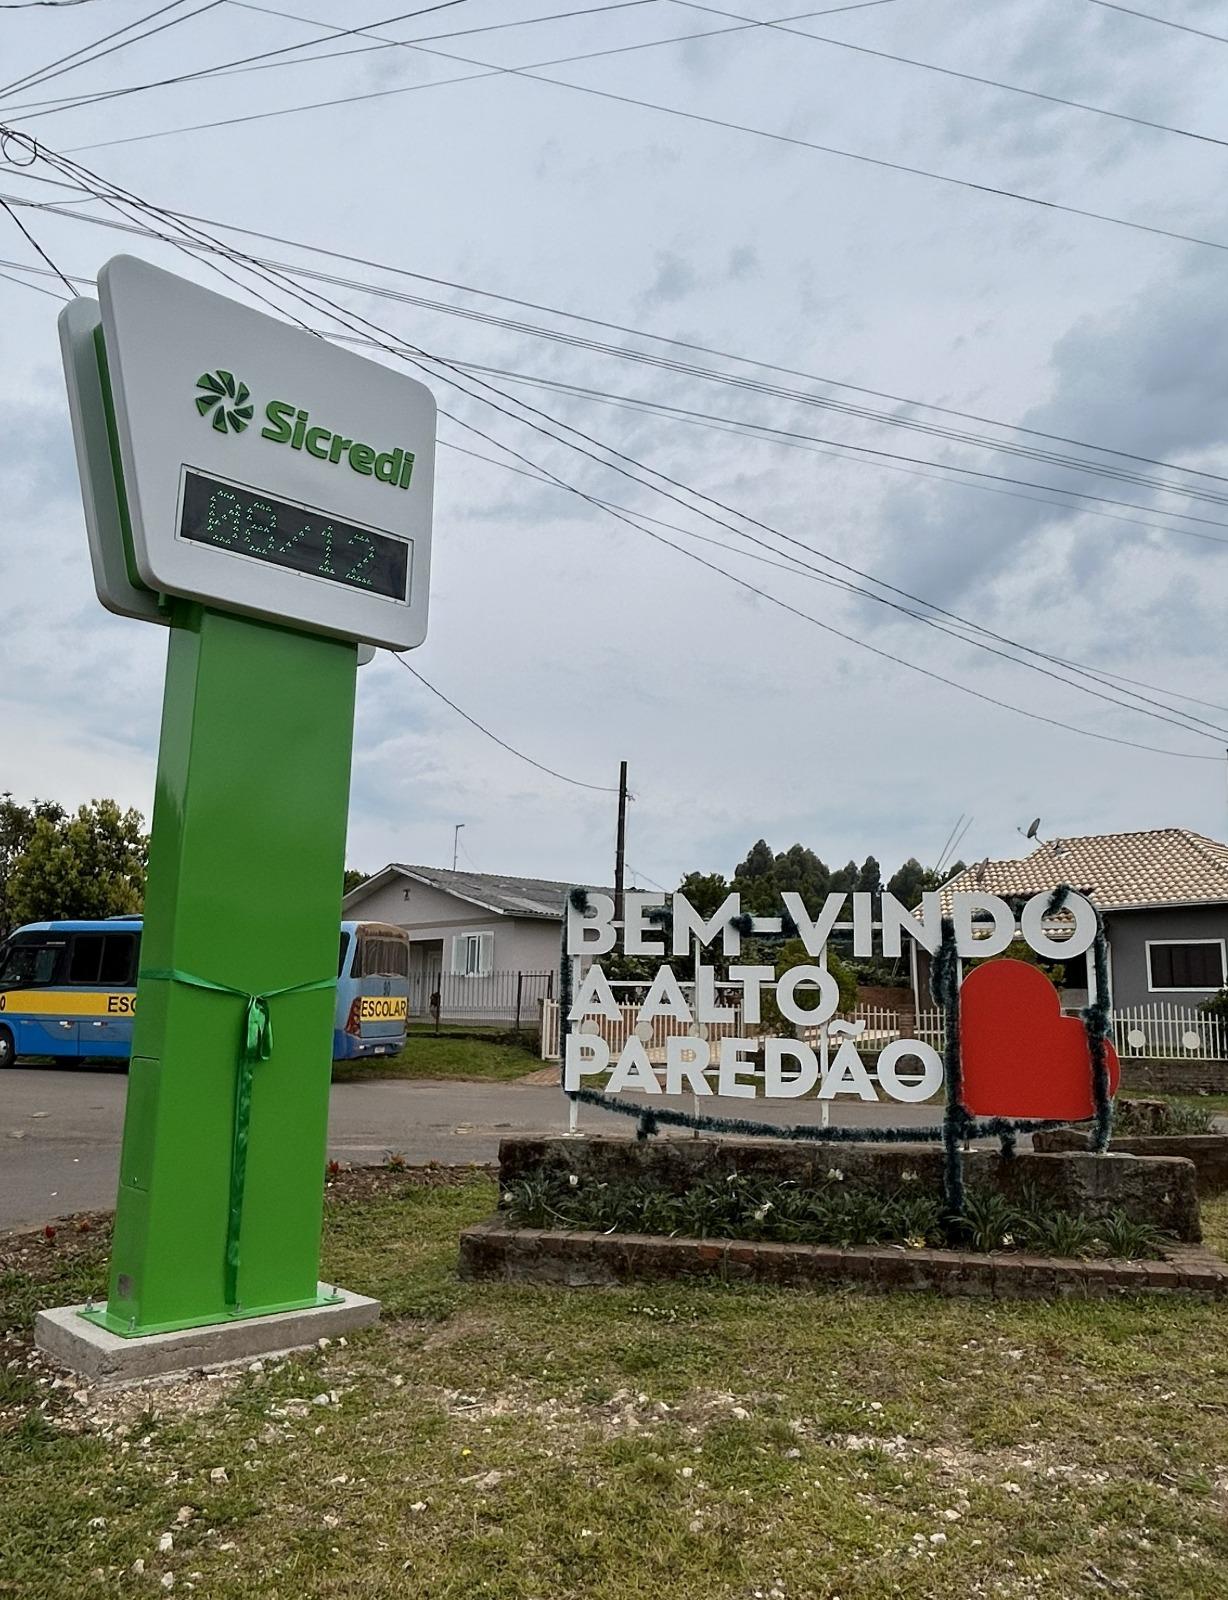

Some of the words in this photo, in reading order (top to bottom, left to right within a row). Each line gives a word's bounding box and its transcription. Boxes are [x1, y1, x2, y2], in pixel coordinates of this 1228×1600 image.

[261, 400, 416, 489] Sicredi
[567, 890, 1097, 959] BEM-VINDO
[361, 1000, 406, 1017] ESCOLAR
[567, 965, 623, 1021] A
[636, 965, 839, 1026] ALTO
[564, 1019, 943, 1103] PAREDÃO
